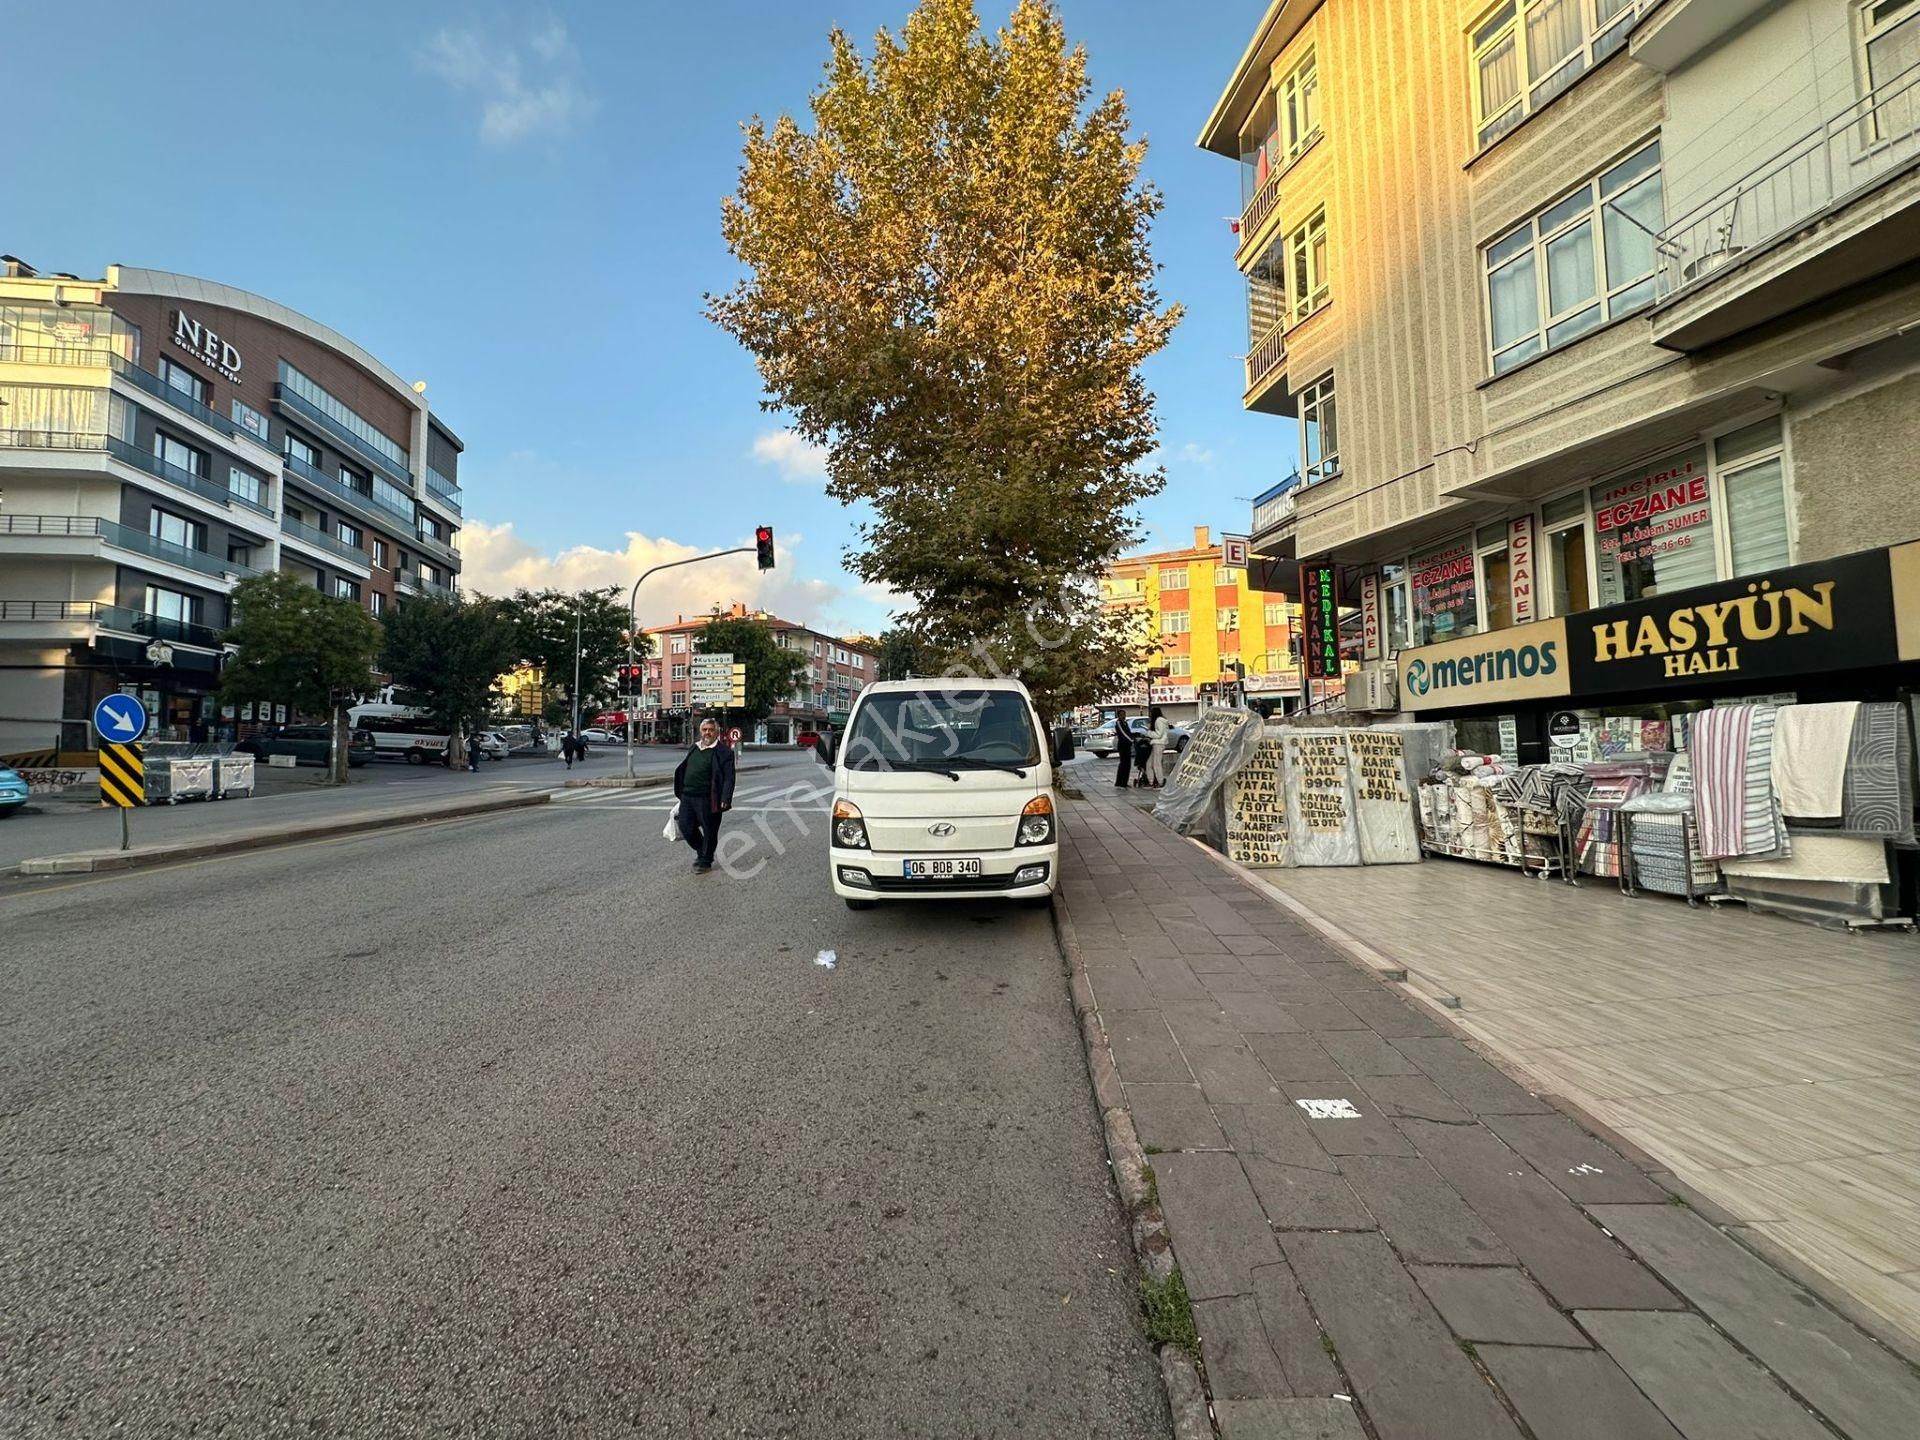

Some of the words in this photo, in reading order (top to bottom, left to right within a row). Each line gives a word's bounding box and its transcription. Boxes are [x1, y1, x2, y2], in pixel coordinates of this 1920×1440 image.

[176, 309, 242, 372] NED
[1595, 475, 1709, 532] ECZANE
[1230, 544, 1242, 561] E
[1412, 555, 1474, 590] ECZANE
[1512, 519, 1530, 613] ECZANE
[1319, 569, 1335, 672] MEDİKAL
[1364, 577, 1376, 649] ECZANE
[1592, 580, 1837, 663] HASYÜN
[1308, 571, 1322, 674] ECZANE
[1432, 641, 1557, 690] merinos
[1664, 647, 1739, 678] HALI
[1290, 737, 1298, 747] 6
[1303, 736, 1346, 746] METRE
[1299, 746, 1335, 756] KARE
[1352, 745, 1359, 754] 4
[1361, 745, 1401, 756] METRE
[1291, 756, 1346, 766] KAYMAZ
[1305, 766, 1335, 776] HALI
[1242, 791, 1277, 803] ALEZİ
[1299, 792, 1343, 804] KAYMAZ
[1235, 812, 1243, 822] 4
[1249, 813, 1284, 824] METRE
[1244, 822, 1273, 832] KARE
[912, 861, 925, 874] 06
[932, 861, 953, 874] BDB
[958, 860, 978, 873] 340
